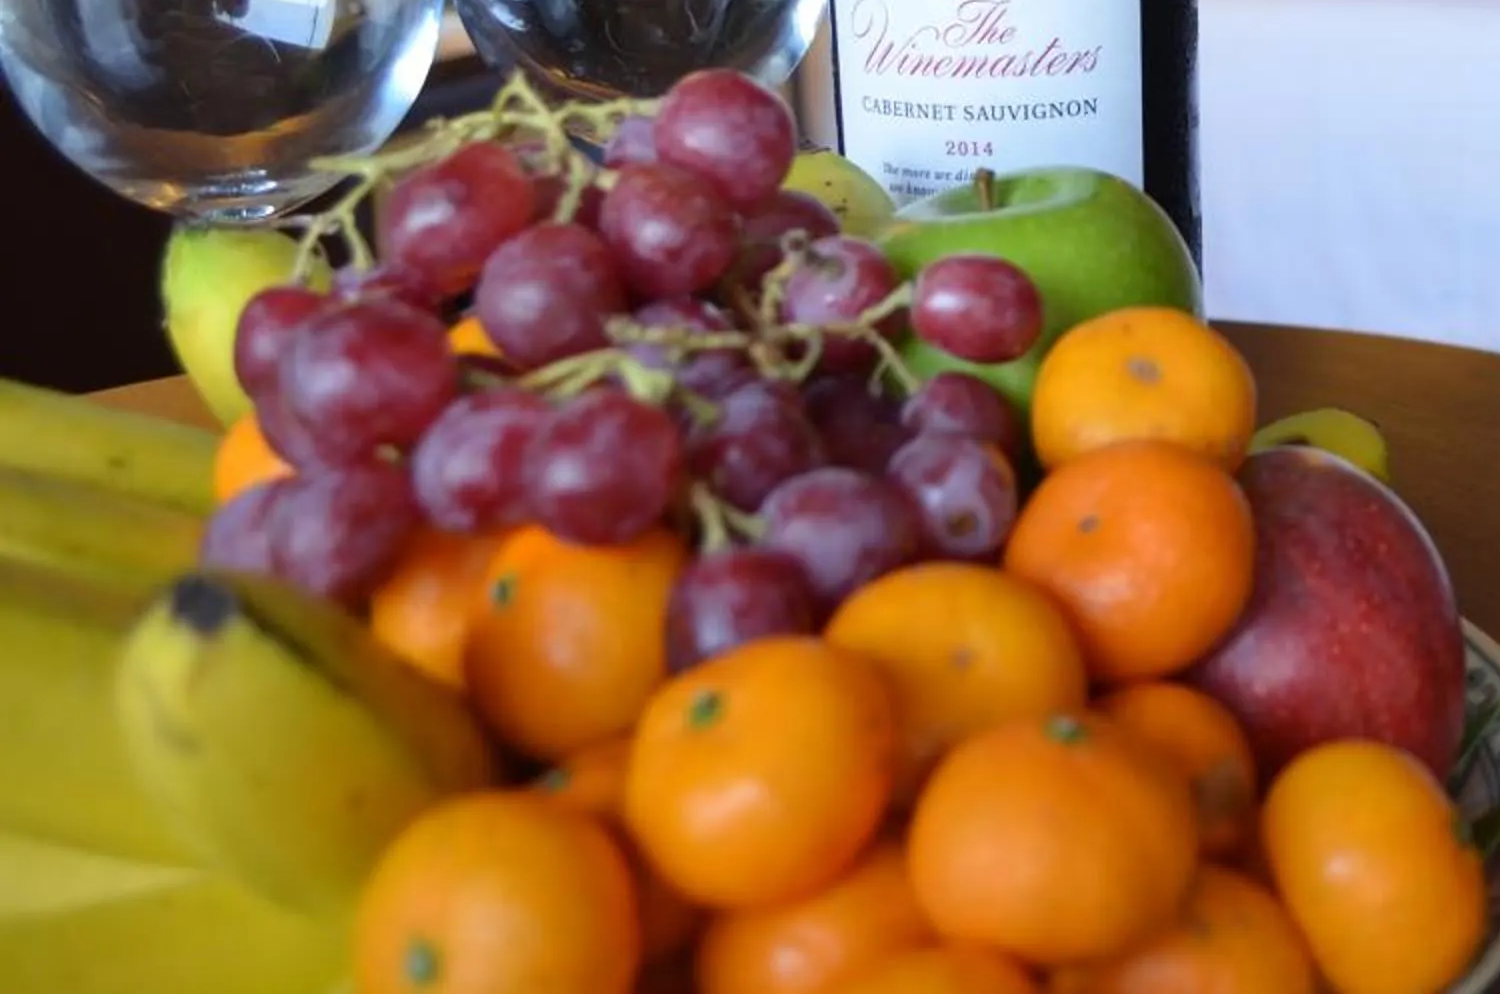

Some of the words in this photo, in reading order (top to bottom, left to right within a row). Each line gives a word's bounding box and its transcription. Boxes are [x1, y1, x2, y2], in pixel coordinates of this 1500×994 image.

[862, 95, 955, 122] CABERNET
[963, 97, 1098, 122] SAUVIGNON
[945, 139, 994, 157] 2014
[902, 167, 931, 180] more
